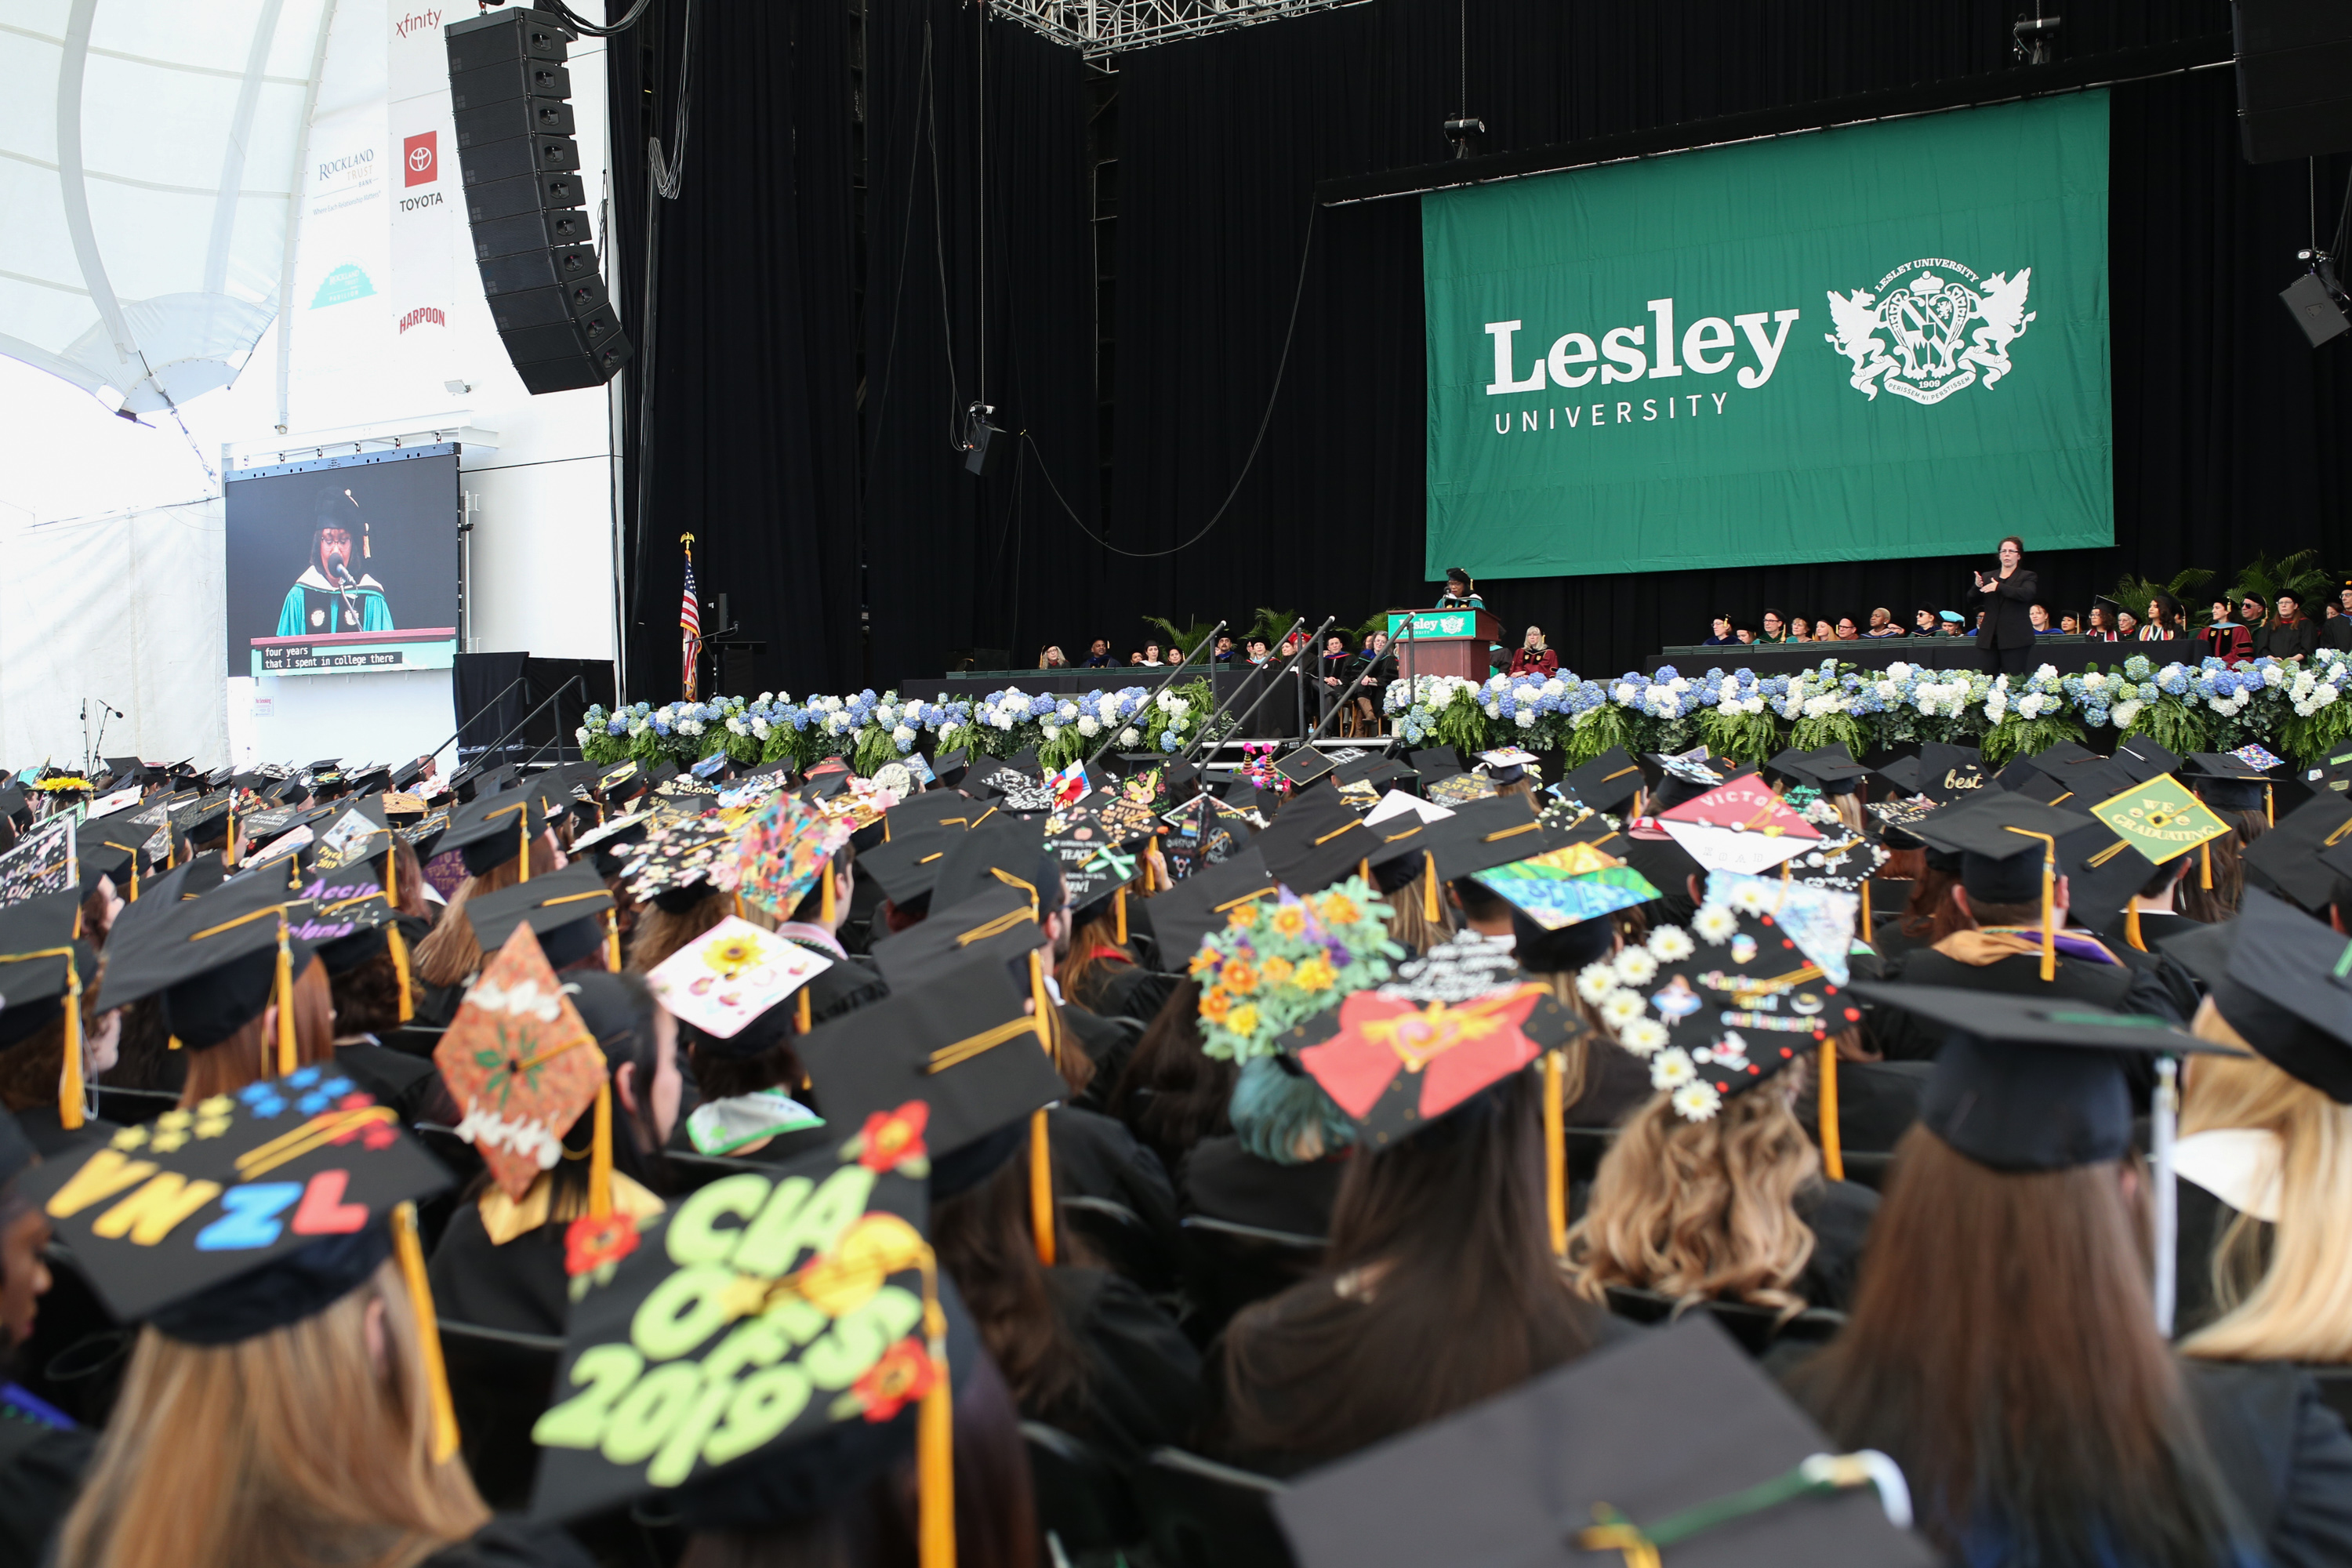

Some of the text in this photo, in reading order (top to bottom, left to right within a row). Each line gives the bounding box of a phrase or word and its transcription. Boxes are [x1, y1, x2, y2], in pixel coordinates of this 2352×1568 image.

[396, 8, 441, 38] xfinity
[319, 148, 374, 181] ROCKLAND
[347, 165, 372, 180] TRUST
[358, 179, 372, 187] BANK
[400, 192, 443, 212] TOYOTA
[1875, 258, 1980, 292] LESLEY UNIVERSITY
[329, 290, 358, 302] PAVILION
[400, 307, 445, 335] HARPOON
[1485, 298, 1799, 396] Lesley
[1888, 383, 1920, 398] PERISSEM
[1931, 376, 1971, 401] PERSTISSEM
[1918, 379, 1940, 389] 1909
[1495, 392, 1727, 434] UNIVERSITY
[1399, 618, 1439, 631] Lsley
[265, 646, 309, 657] four years
[265, 654, 394, 669] that I spent in college there
[1944, 767, 1984, 789] best
[1430, 785, 1449, 795] THE
[1699, 790, 1792, 818] VICTORY
[2141, 798, 2175, 813] WE
[1123, 822, 1153, 833] AGAIN
[2111, 813, 2216, 841] GRADUATING
[1817, 833, 1849, 850] Best
[318, 846, 344, 859] Psych
[316, 858, 338, 869] 2019
[45, 1148, 369, 1251] VNZL
[531, 1341, 814, 1489] 2019
